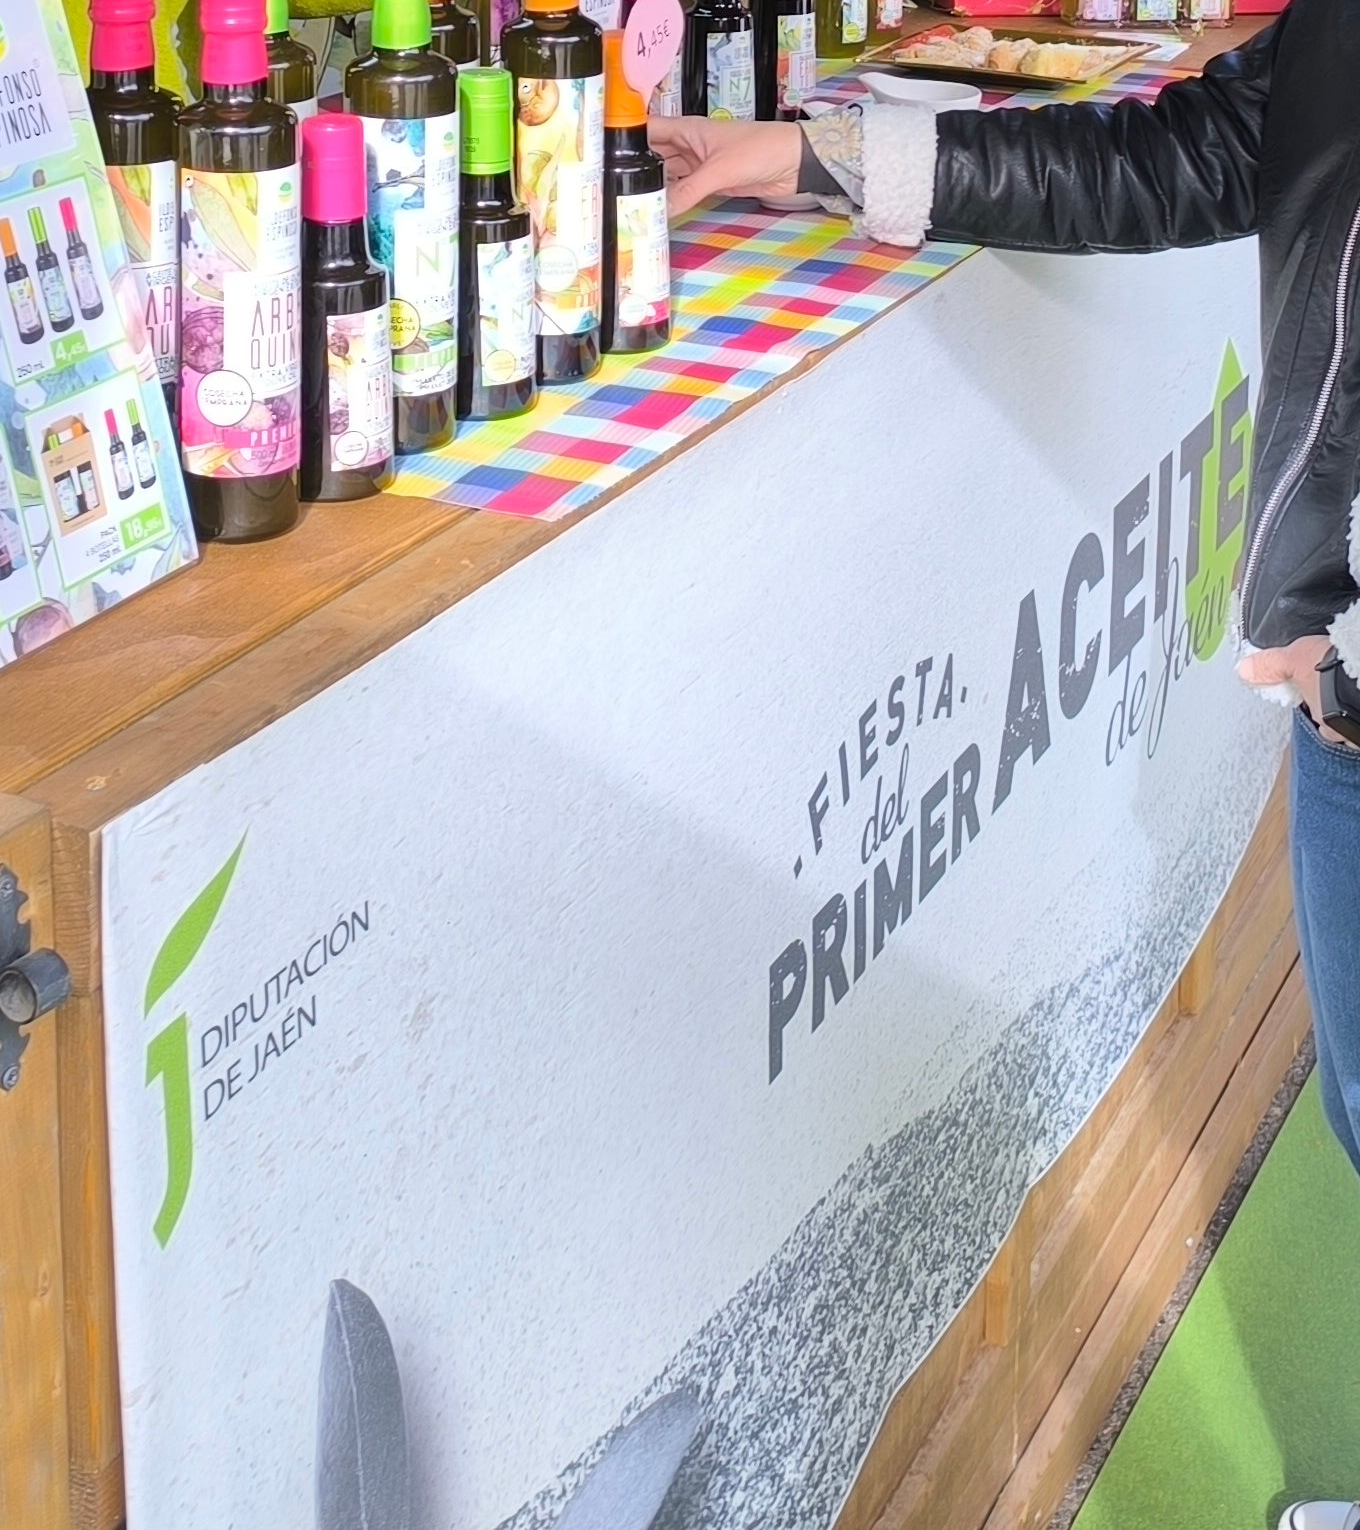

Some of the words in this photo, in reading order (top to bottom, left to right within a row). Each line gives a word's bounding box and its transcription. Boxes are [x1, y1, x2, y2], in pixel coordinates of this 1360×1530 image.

[636, 18, 672, 60] 4,45€
[769, 742, 982, 1085] PRIMER
[991, 373, 1252, 816] ACEITE
[1104, 657, 1147, 767] de
[1146, 556, 1231, 760] Jaén
[860, 743, 910, 865] del
[200, 900, 370, 1069] DIPUTACIÓN
[203, 1060, 243, 1122] DE
[247, 995, 317, 1084] JAÉN
